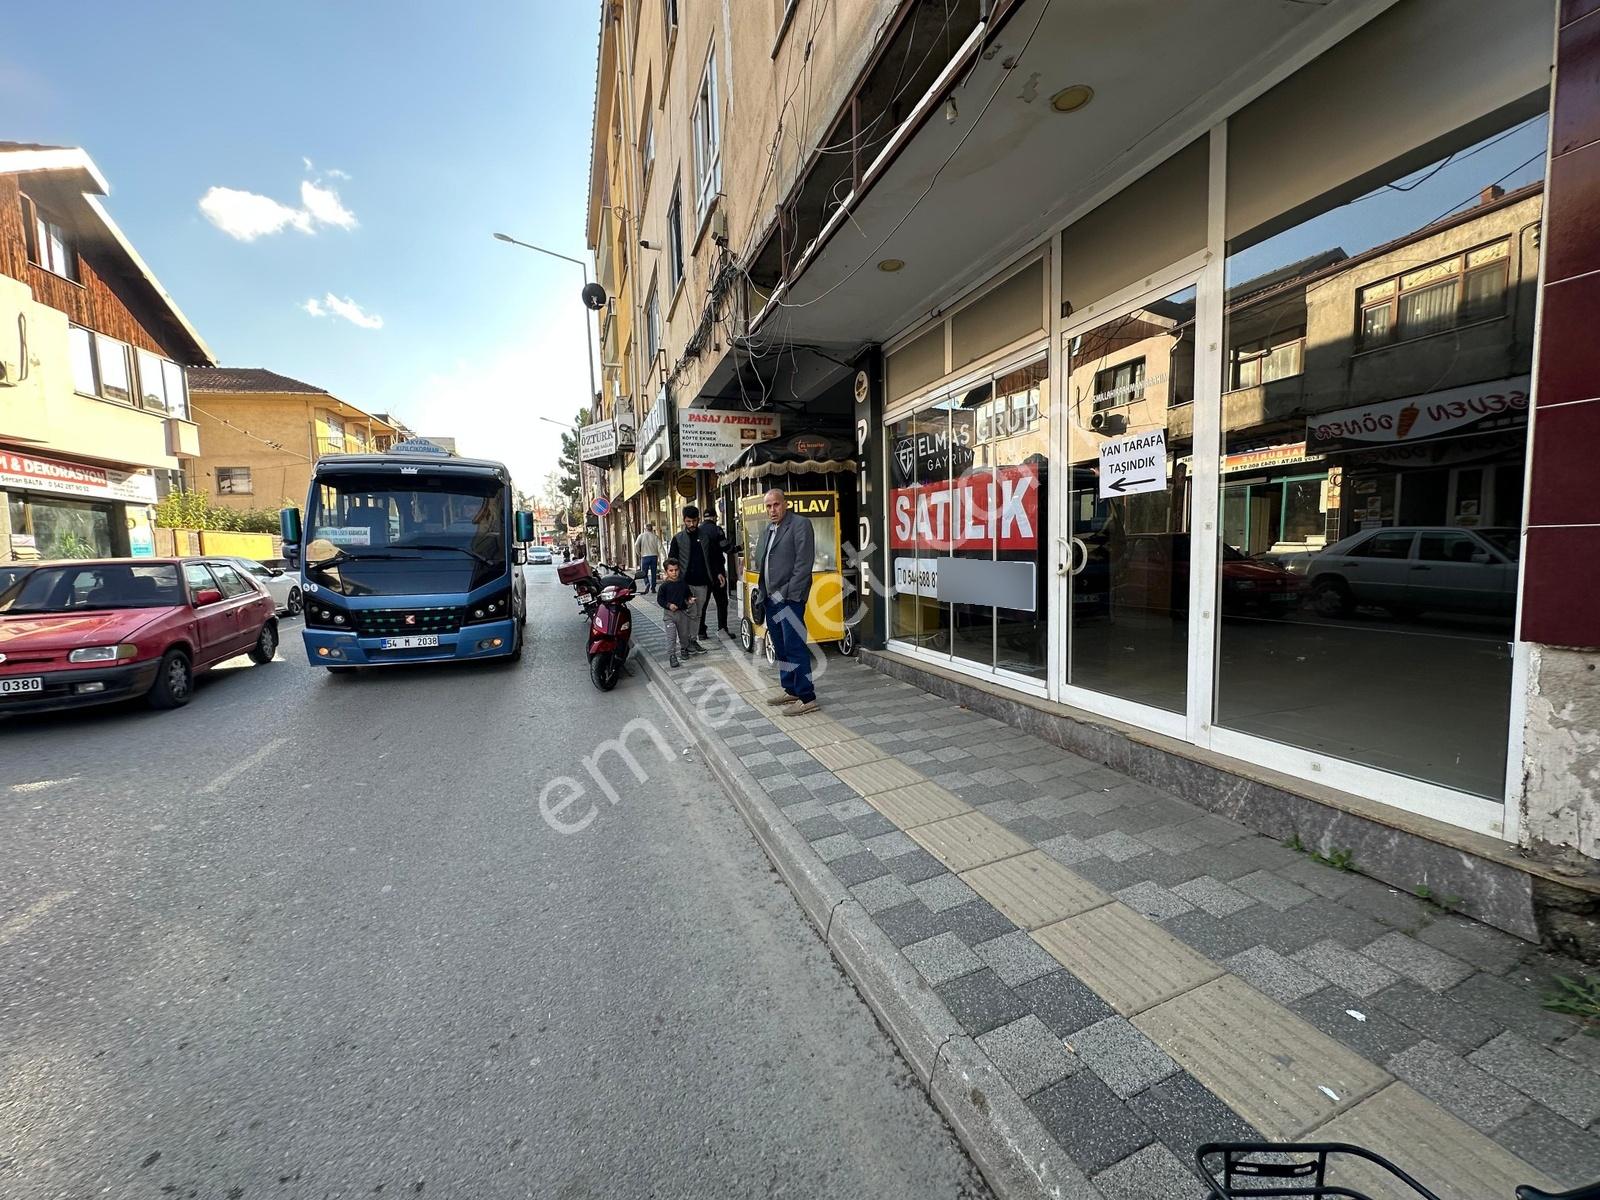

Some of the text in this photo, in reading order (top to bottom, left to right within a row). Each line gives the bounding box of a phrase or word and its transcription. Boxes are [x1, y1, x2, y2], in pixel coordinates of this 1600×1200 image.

[687, 413, 774, 426] PASAJ APERATİF
[581, 429, 614, 447] ÖZTÜRK
[918, 402, 1038, 457] ELMAS GRUP
[405, 438, 430, 446] AKYAZI
[1101, 434, 1164, 457] YAN TARAFA
[10, 456, 21, 472] &
[23, 458, 106, 484] DEKORASYON
[1109, 456, 1156, 475] TAŞINDIK
[24, 477, 43, 486] BALTA
[895, 475, 1035, 541] SATILIK
[386, 637, 438, 648] 54 M 2038
[2, 679, 39, 692] 0380
